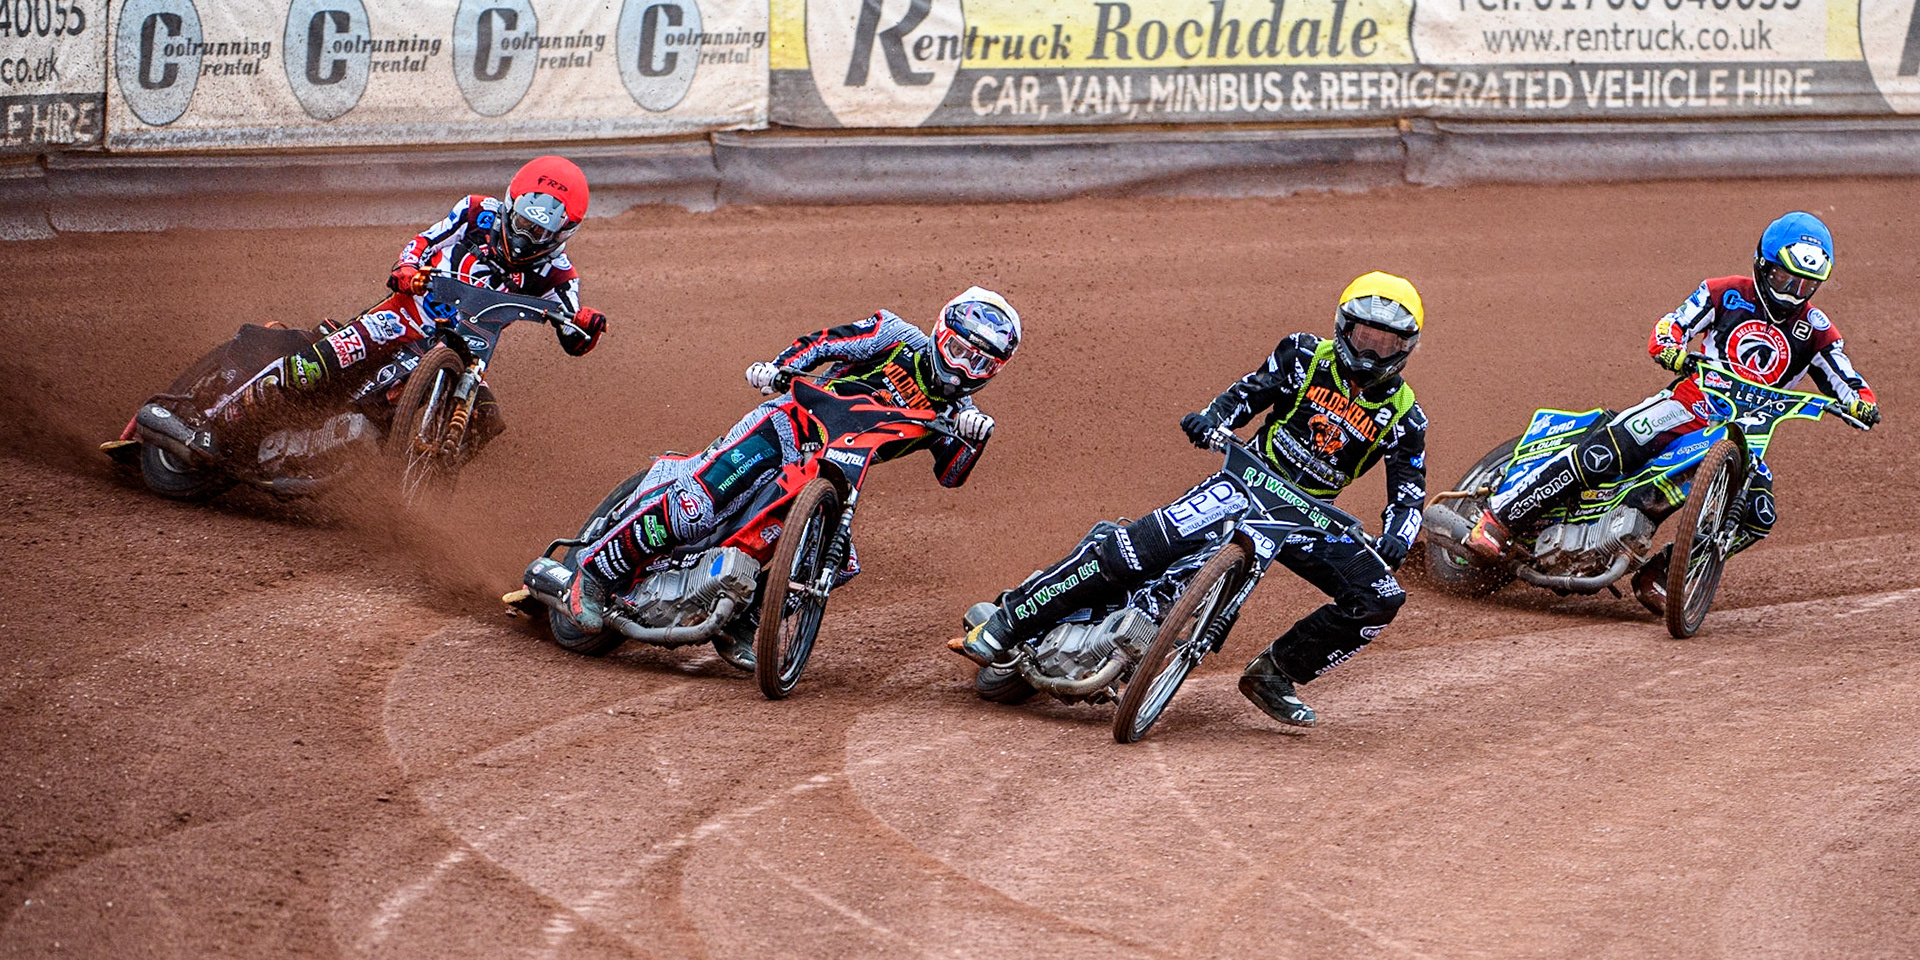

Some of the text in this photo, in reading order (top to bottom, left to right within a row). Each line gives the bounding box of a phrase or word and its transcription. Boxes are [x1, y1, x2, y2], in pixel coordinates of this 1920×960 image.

[1086, 0, 1379, 60] Rochdale
[1483, 20, 1773, 52] www.rentruck.co.uk
[203, 59, 260, 76] rental
[371, 56, 427, 73] rental
[540, 51, 592, 69] rental
[700, 48, 750, 66] rental
[971, 68, 1815, 118] CAR, VAN, MINIBUS & REFRIGERATED VEHICLE HIRE
[30, 102, 95, 144] HIRE
[1735, 324, 1757, 338] BELLE
[1793, 321, 1809, 339] 2
[881, 361, 935, 411] MILDENH
[1739, 382, 1791, 401] TRENT
[1305, 385, 1378, 442] MILDENHALL
[1374, 407, 1393, 427] 2
[718, 454, 764, 492] THERMOHOME
[825, 448, 866, 467] BOWTELL
[1166, 483, 1235, 524] EPD
[1264, 477, 1310, 514] Warren
[1308, 506, 1331, 530] Ltd
[1509, 469, 1574, 520] daytona
[1180, 511, 1223, 535] INSULATION
[1014, 559, 1100, 620] R J Warren Ltd
